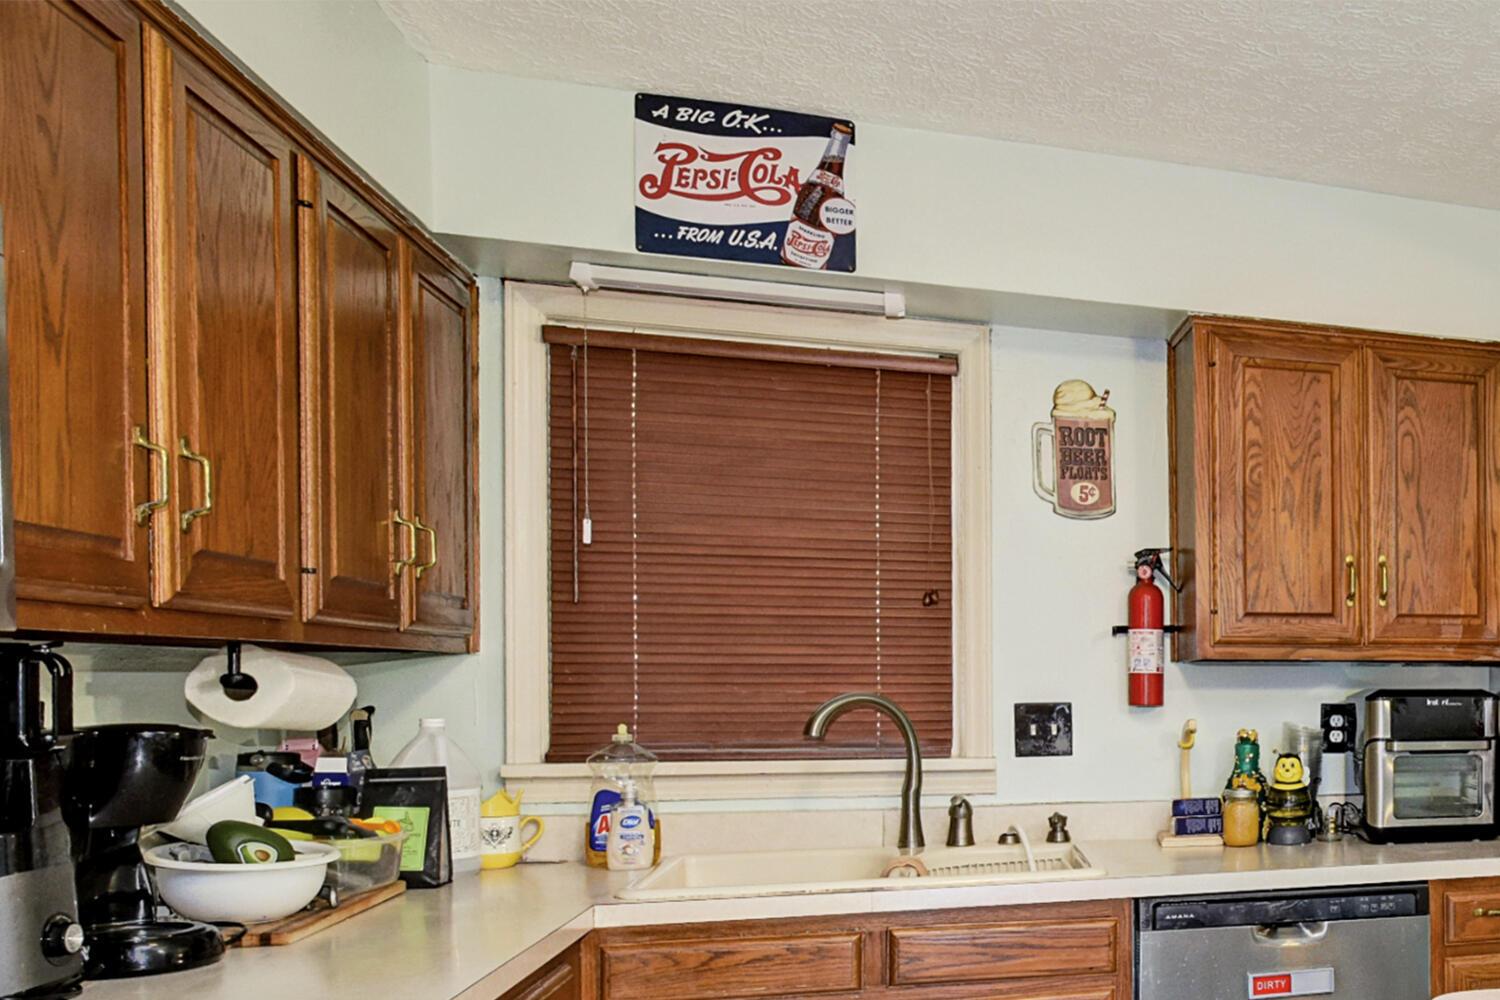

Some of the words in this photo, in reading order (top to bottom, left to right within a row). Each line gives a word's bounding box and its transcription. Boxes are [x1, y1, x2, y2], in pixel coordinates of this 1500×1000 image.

[651, 105, 669, 119] A
[675, 107, 716, 124] BIG
[825, 206, 854, 215] BIGGER
[826, 217, 853, 226] BETTER
[728, 229, 778, 250] U.S.A.
[1058, 426, 1108, 447] ROOT
[1060, 447, 1107, 467] BEER
[1060, 466, 1108, 481] FLOATS
[1079, 485, 1097, 502] 5¢
[1256, 979, 1287, 991] DIRTY
